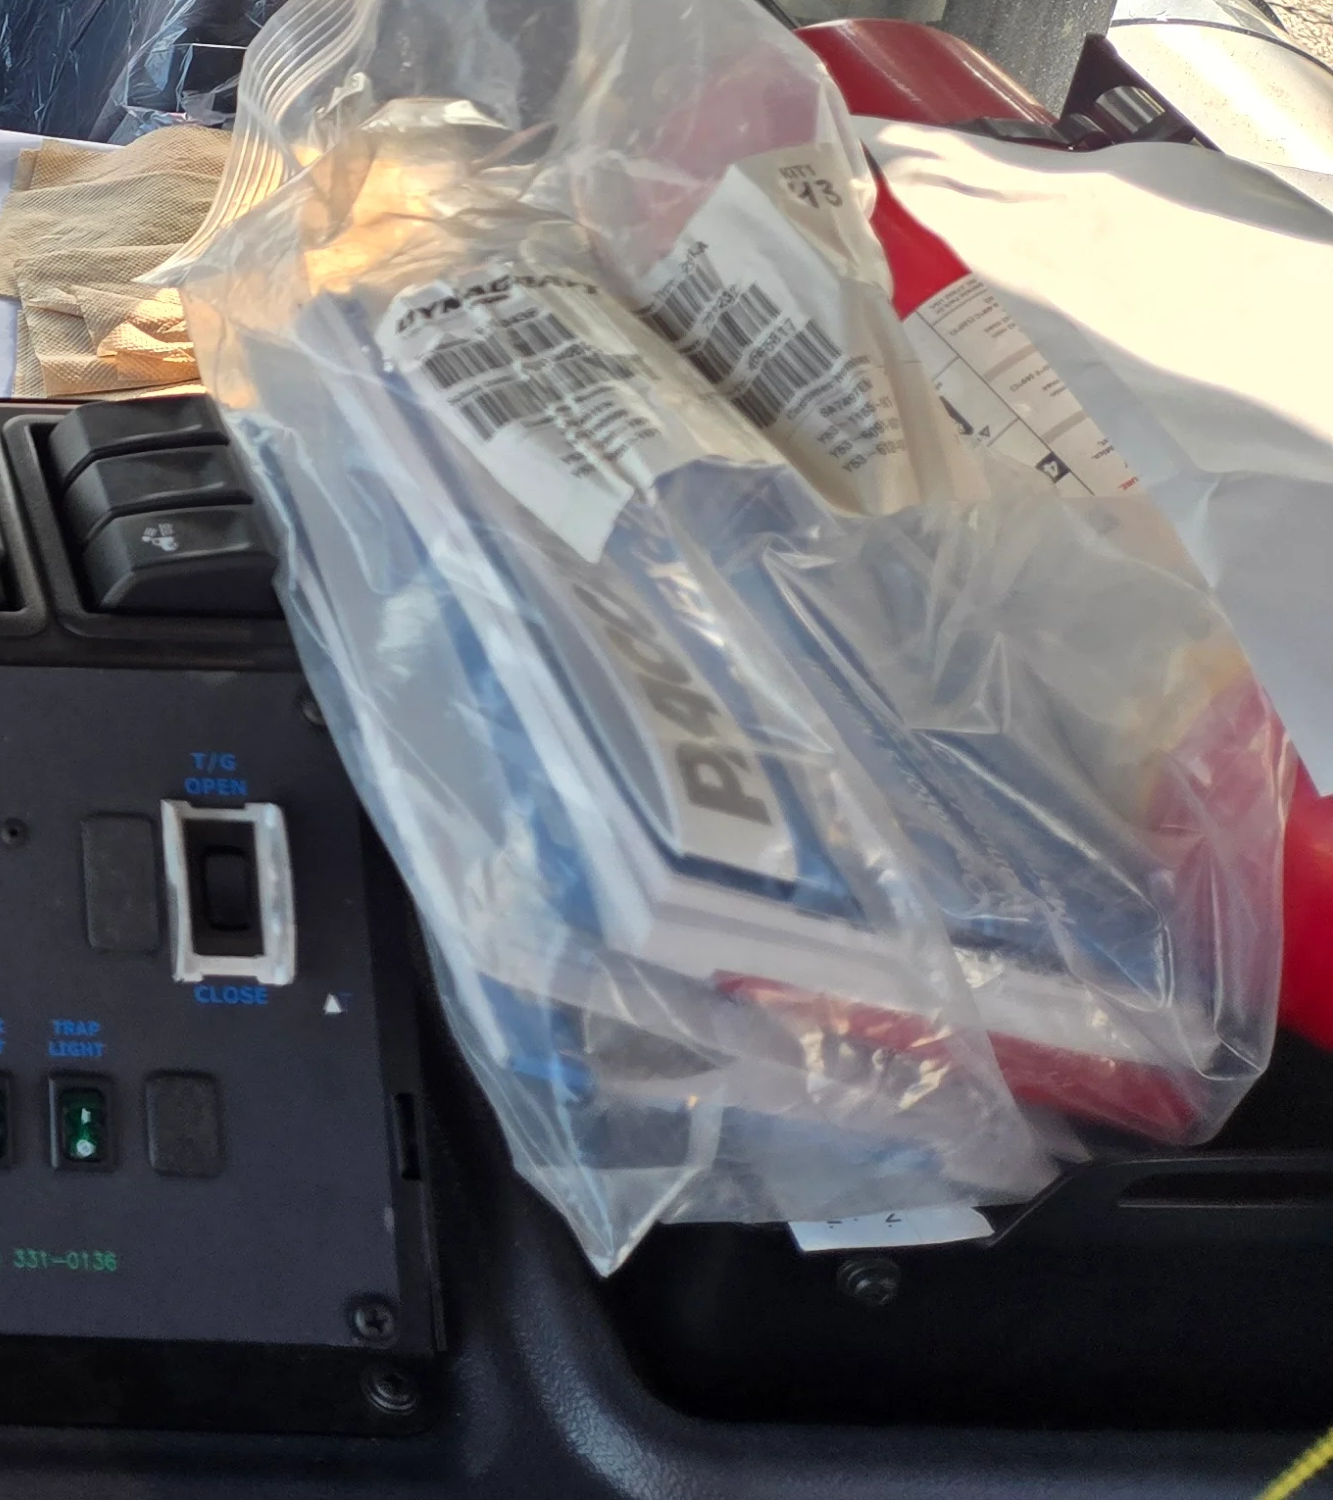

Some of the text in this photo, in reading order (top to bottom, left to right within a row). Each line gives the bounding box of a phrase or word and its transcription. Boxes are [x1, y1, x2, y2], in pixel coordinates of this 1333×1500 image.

[191, 752, 237, 772] T/G
[184, 778, 248, 796] OPEN
[192, 985, 268, 1005] CLOSE
[52, 1019, 101, 1036] TRAP
[47, 1039, 106, 1057] LIGHT
